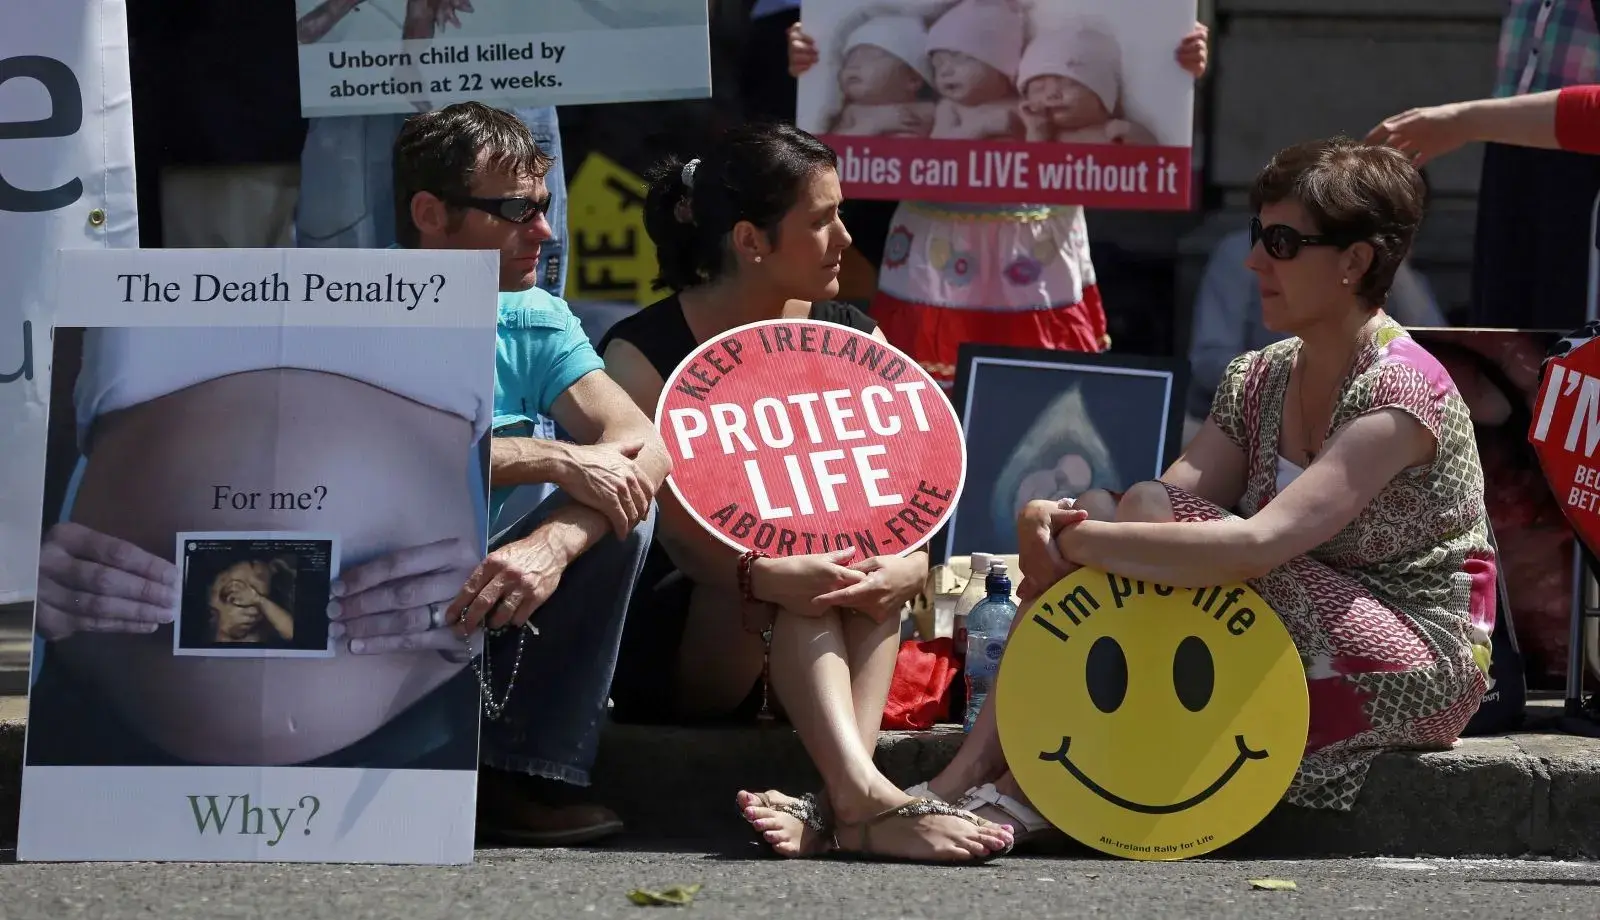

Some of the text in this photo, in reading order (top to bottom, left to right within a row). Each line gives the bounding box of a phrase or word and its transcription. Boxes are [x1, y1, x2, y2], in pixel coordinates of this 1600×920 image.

[328, 41, 566, 69] Unborn child killed by
[329, 71, 563, 98] abortion at 22 weeks.
[909, 156, 958, 187] can
[968, 150, 1031, 189] LIVE
[1038, 153, 1148, 193] without
[1157, 157, 1177, 194] it
[117, 272, 446, 311] The Death Penalty?
[675, 326, 907, 402] KEEP IRELAND
[669, 381, 932, 460] PROTECT
[211, 485, 328, 511] For me?
[744, 444, 904, 521] LIFE
[1567, 486, 1600, 515] BET
[709, 479, 953, 557] ABORTION-FREE
[1032, 585, 1101, 642] I'm
[186, 793, 320, 847] Why?
[1099, 835, 1215, 853] All-Ireland Rally for Life
